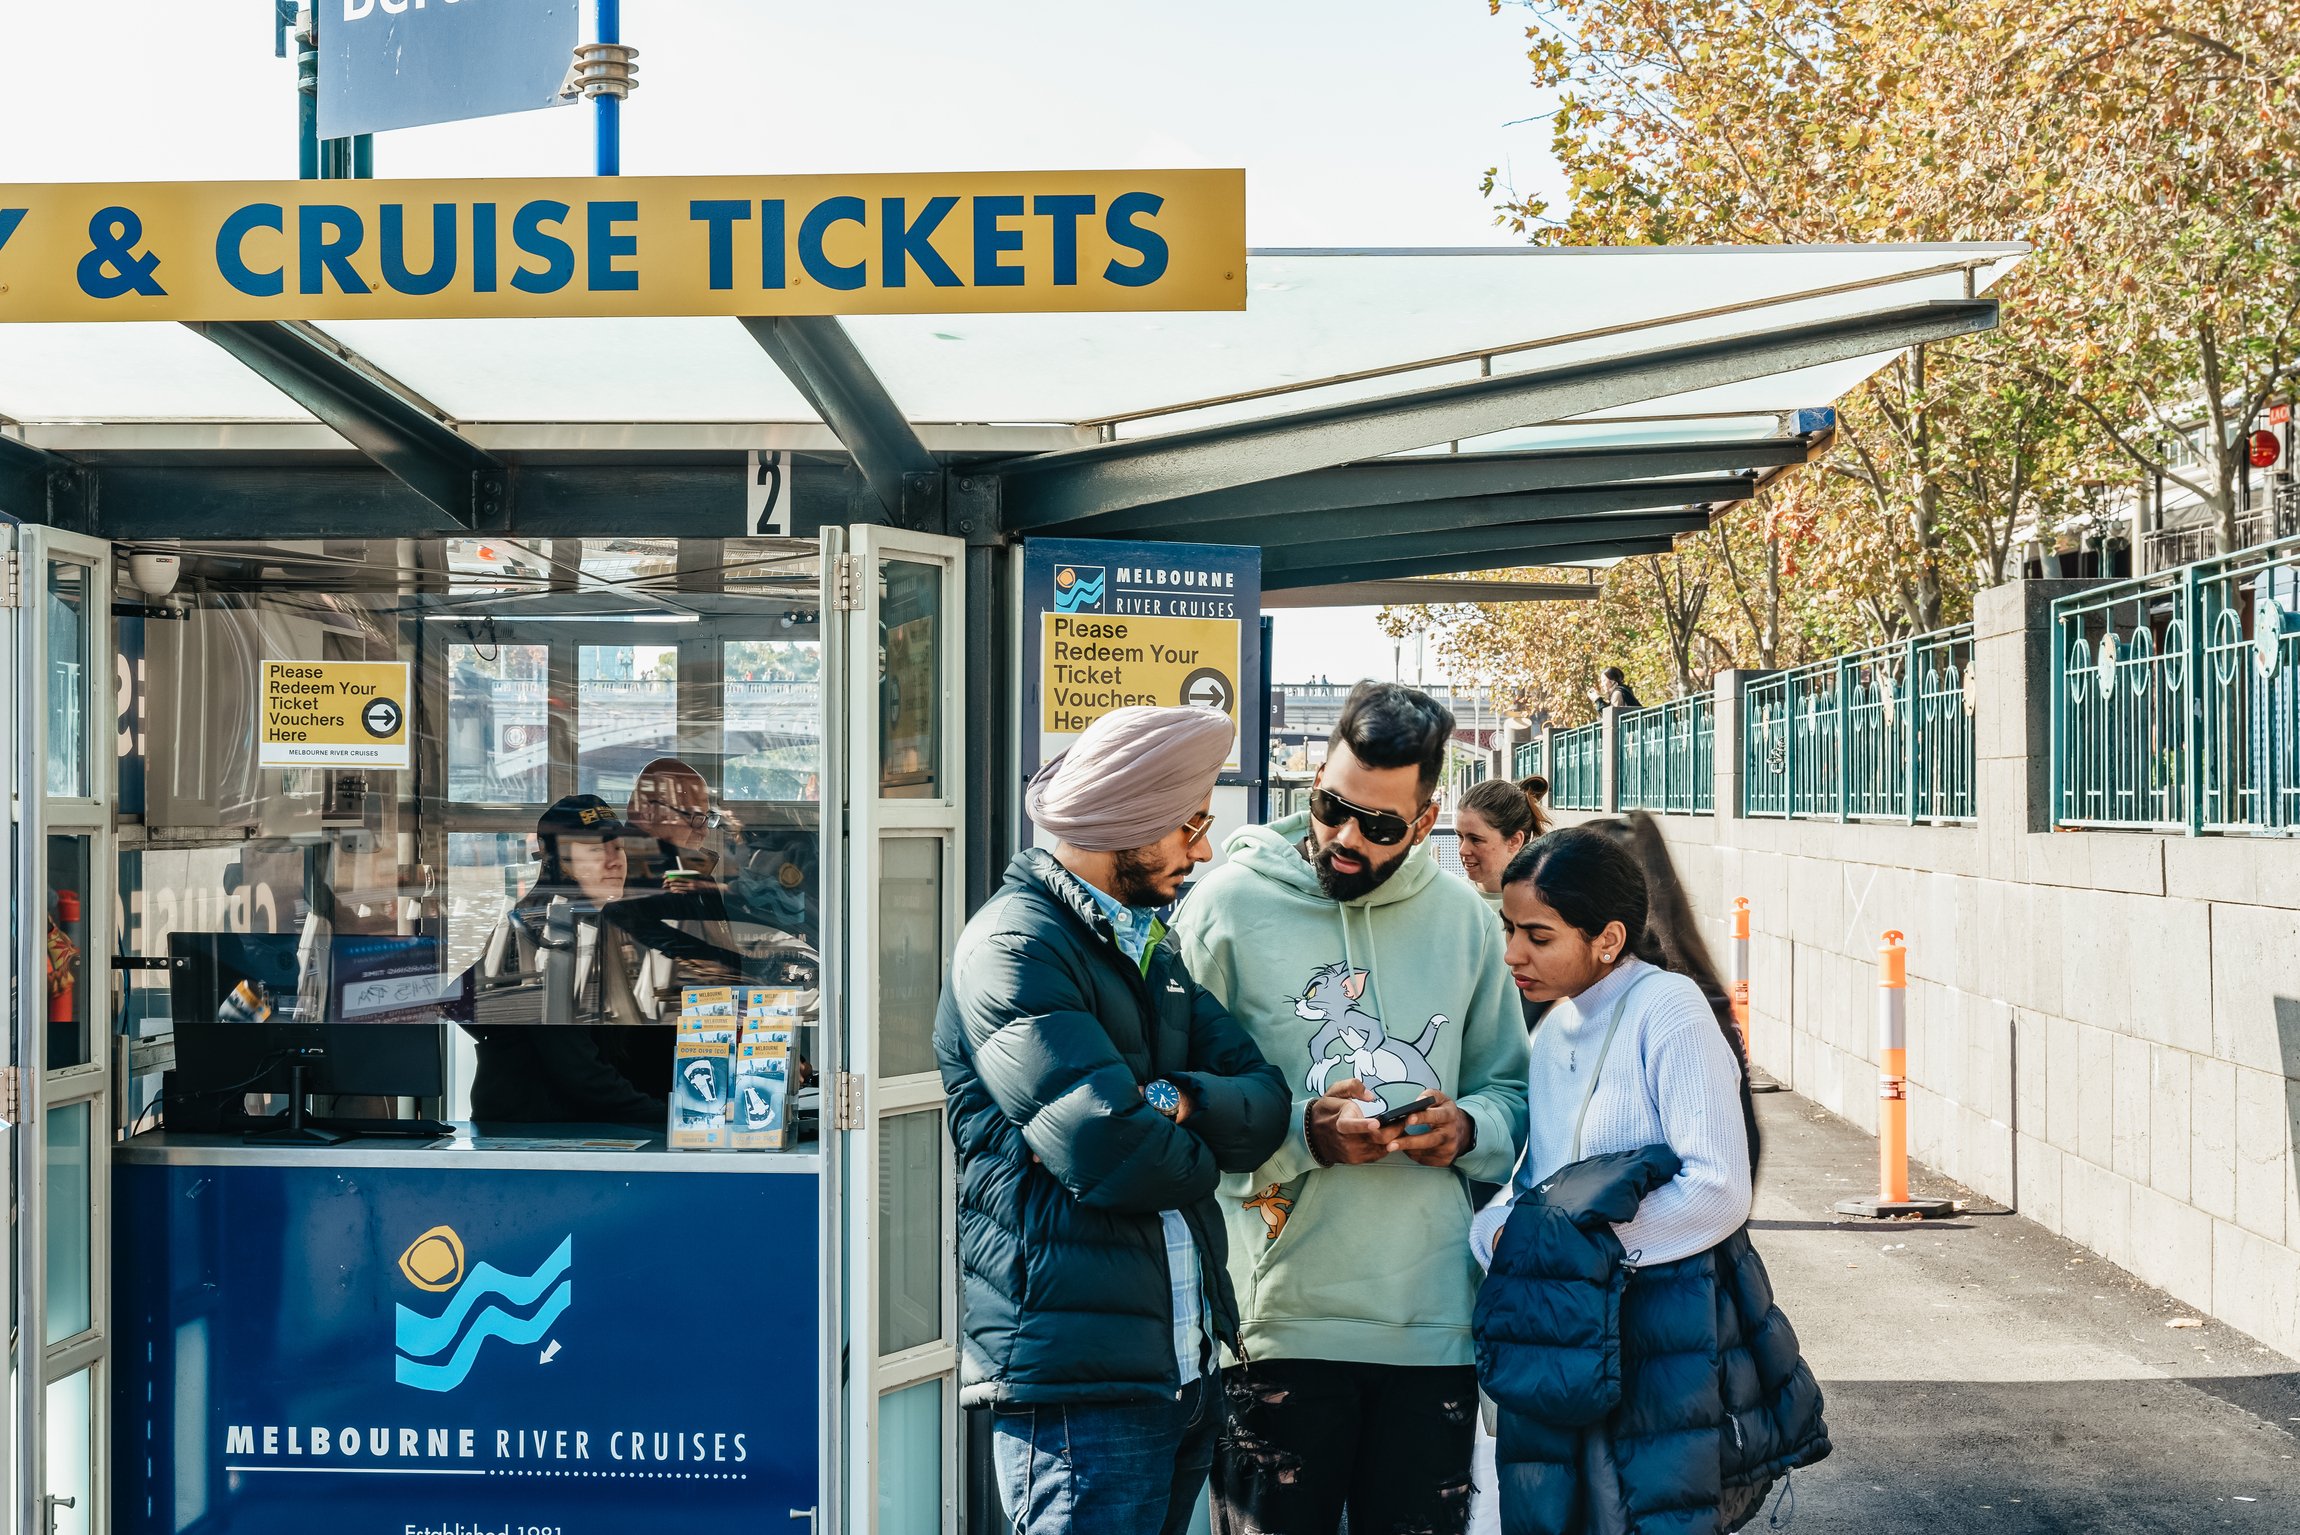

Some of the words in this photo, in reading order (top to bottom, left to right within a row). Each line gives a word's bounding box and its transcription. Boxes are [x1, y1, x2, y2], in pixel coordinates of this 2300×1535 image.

[76, 206, 169, 299] &
[216, 200, 639, 297] CRUISE
[689, 192, 1170, 291] TICKETS
[757, 464, 781, 535] 2
[1116, 567, 1234, 588] MELBOURNE
[1116, 598, 1161, 615] RIVER
[1170, 600, 1234, 618] CRUISES
[1055, 618, 1128, 639] Please
[1055, 641, 1144, 662] Redeem
[1150, 644, 1199, 664] Your
[270, 665, 323, 679] Please
[1054, 664, 1122, 685] Ticket
[270, 681, 335, 695] Redeem
[339, 682, 377, 696] Your
[1053, 687, 1157, 708] Vouchers
[269, 697, 319, 710] Ticket
[1272, 705, 1278, 714] 3
[269, 712, 345, 726] Vouchers
[269, 728, 307, 741] Here
[225, 1426, 475, 1457] MELBOURNE
[496, 1429, 590, 1460] RIVER
[610, 1431, 747, 1462] CRUISES
